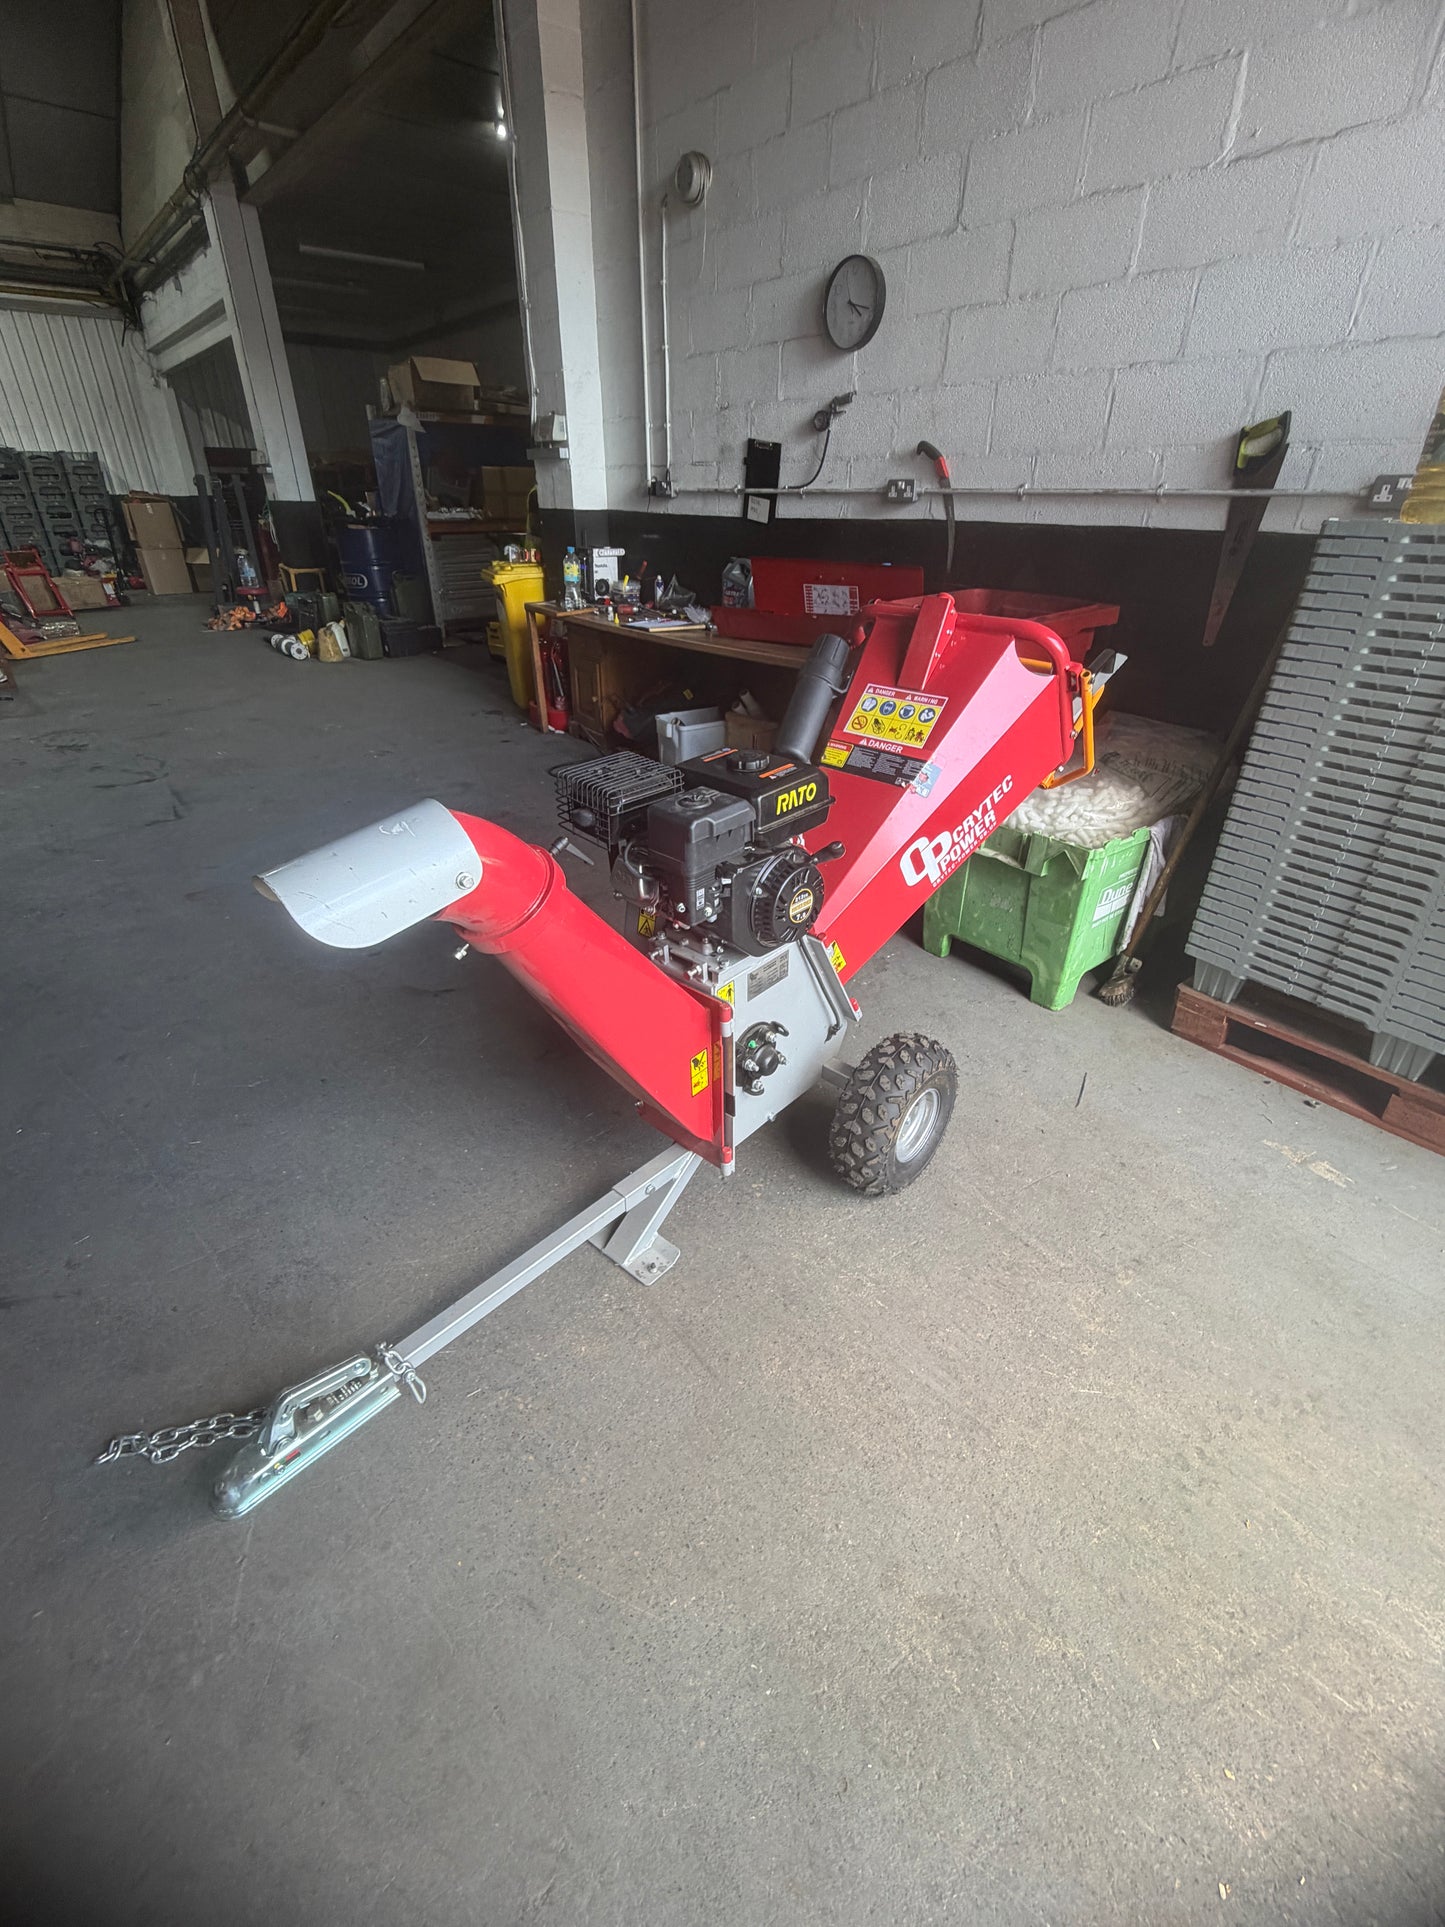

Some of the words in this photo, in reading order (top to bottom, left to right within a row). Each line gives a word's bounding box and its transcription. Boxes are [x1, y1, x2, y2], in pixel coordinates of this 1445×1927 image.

[875, 688, 896, 697] DANGER
[913, 696, 939, 705] WARNING
[868, 739, 903, 754] DANGER
[776, 782, 817, 816] RATO
[952, 774, 1013, 843] CRYTEC
[940, 810, 996, 872] POWER
